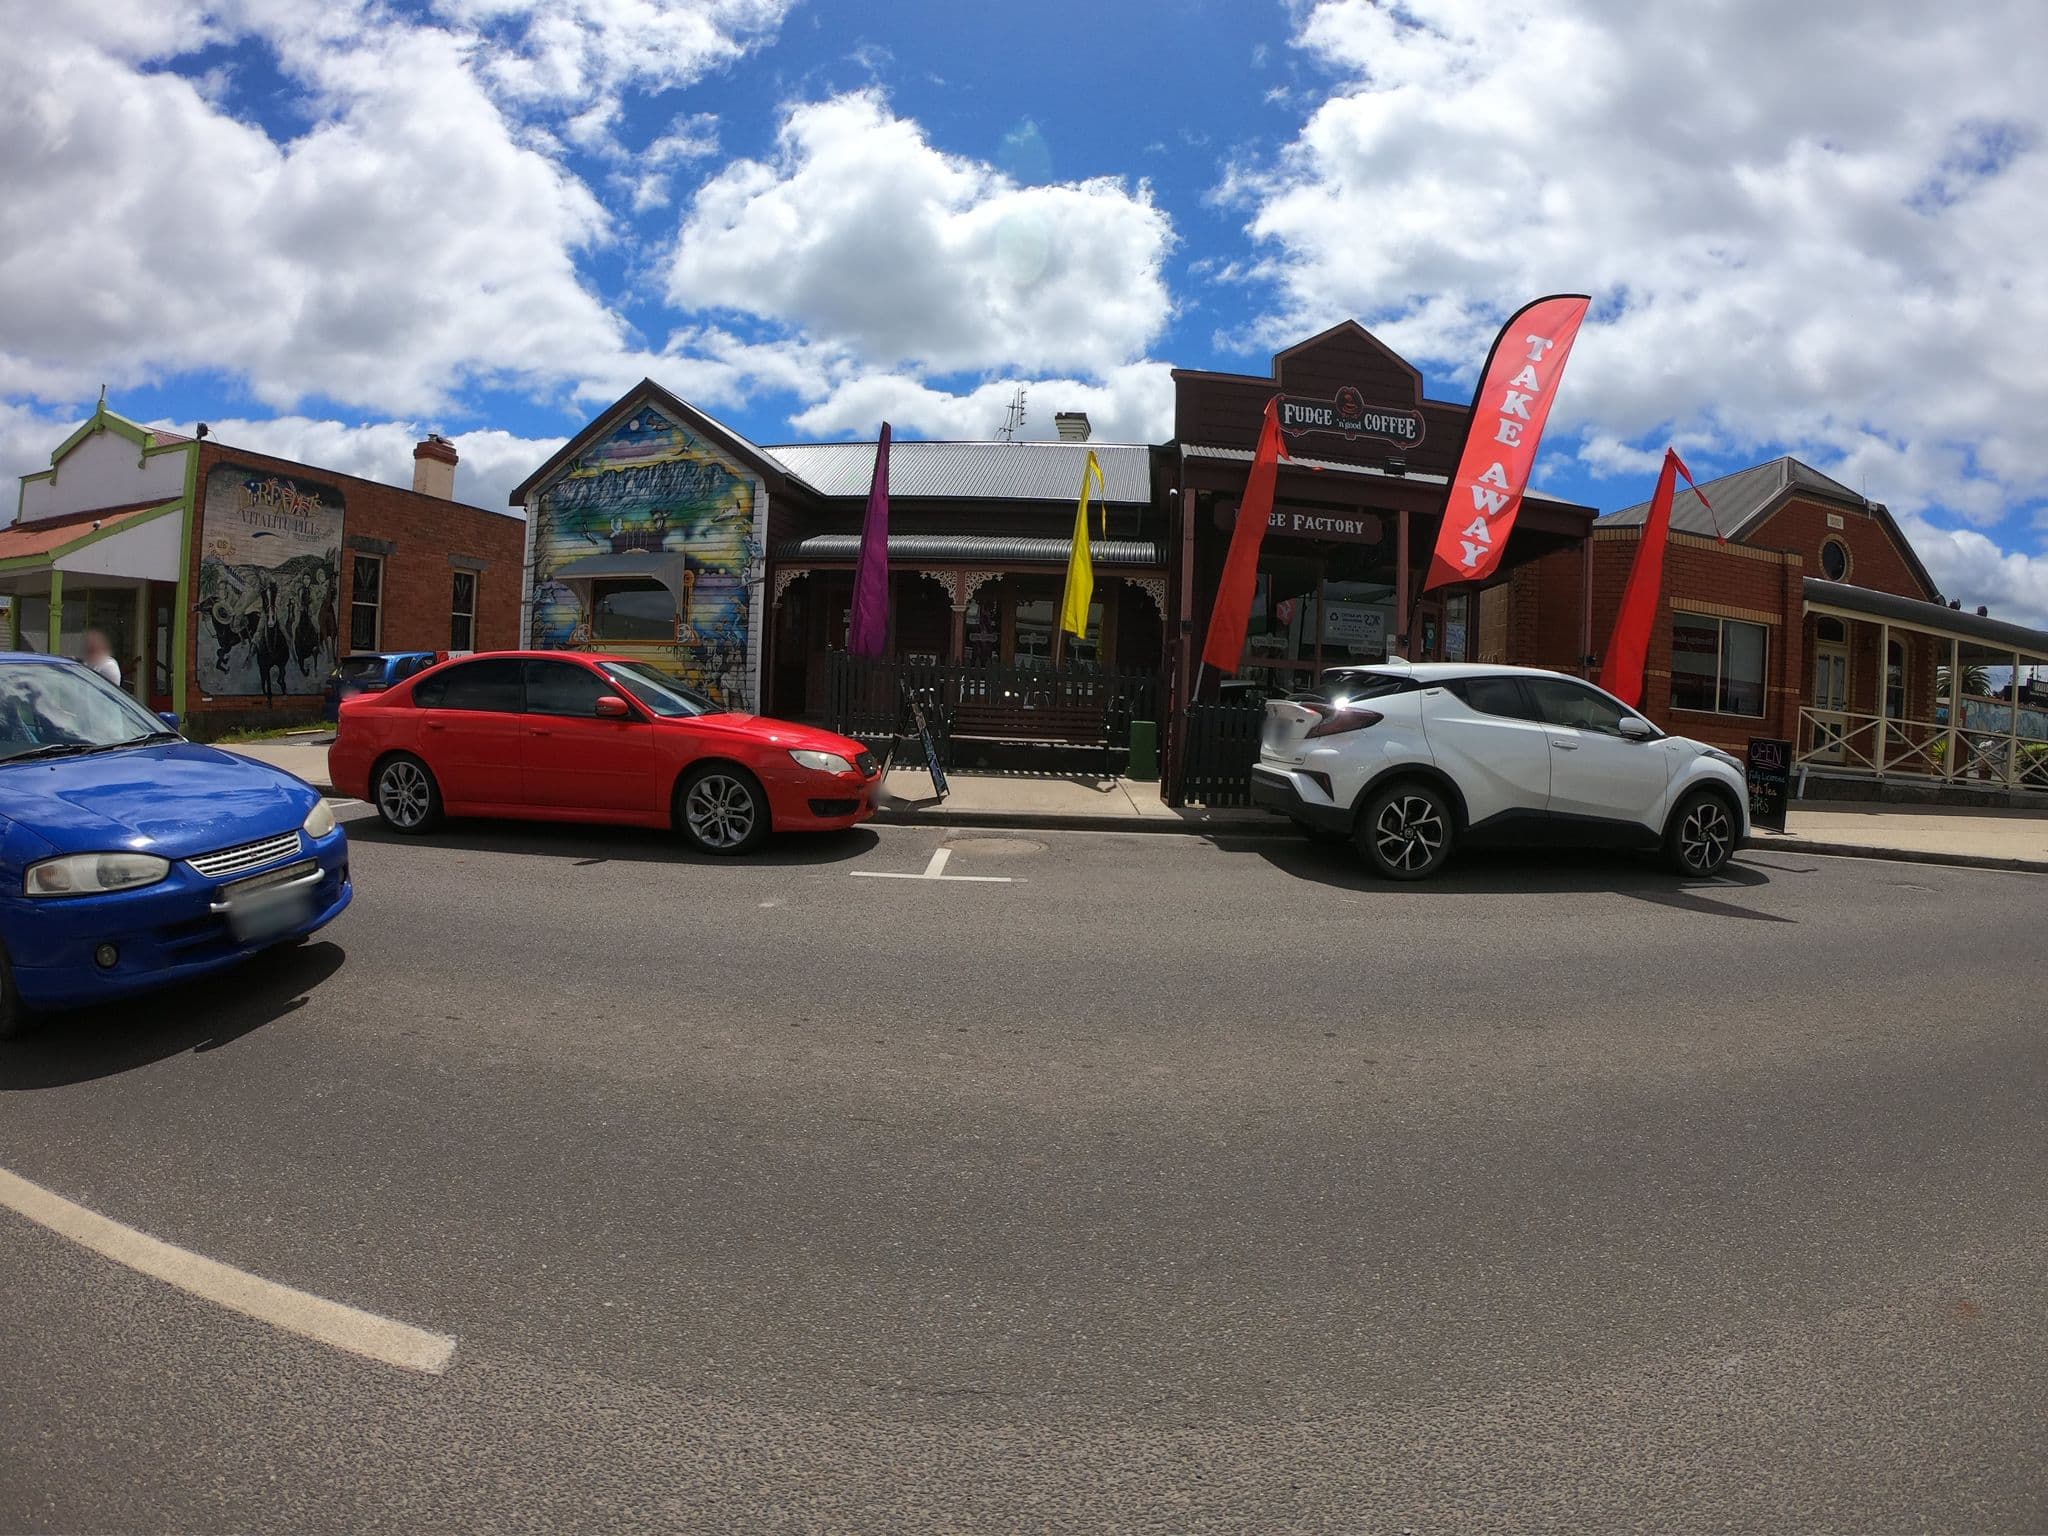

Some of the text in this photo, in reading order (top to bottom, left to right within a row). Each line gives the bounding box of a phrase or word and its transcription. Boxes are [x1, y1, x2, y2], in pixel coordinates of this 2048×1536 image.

[1283, 403, 1333, 426] FUDGE
[1345, 421, 1362, 431] good
[1364, 413, 1416, 439] COFFEE
[1460, 334, 1553, 568] TAKE AWAY
[1292, 513, 1364, 535] FACTORY
[1751, 743, 1781, 765] OPEN
